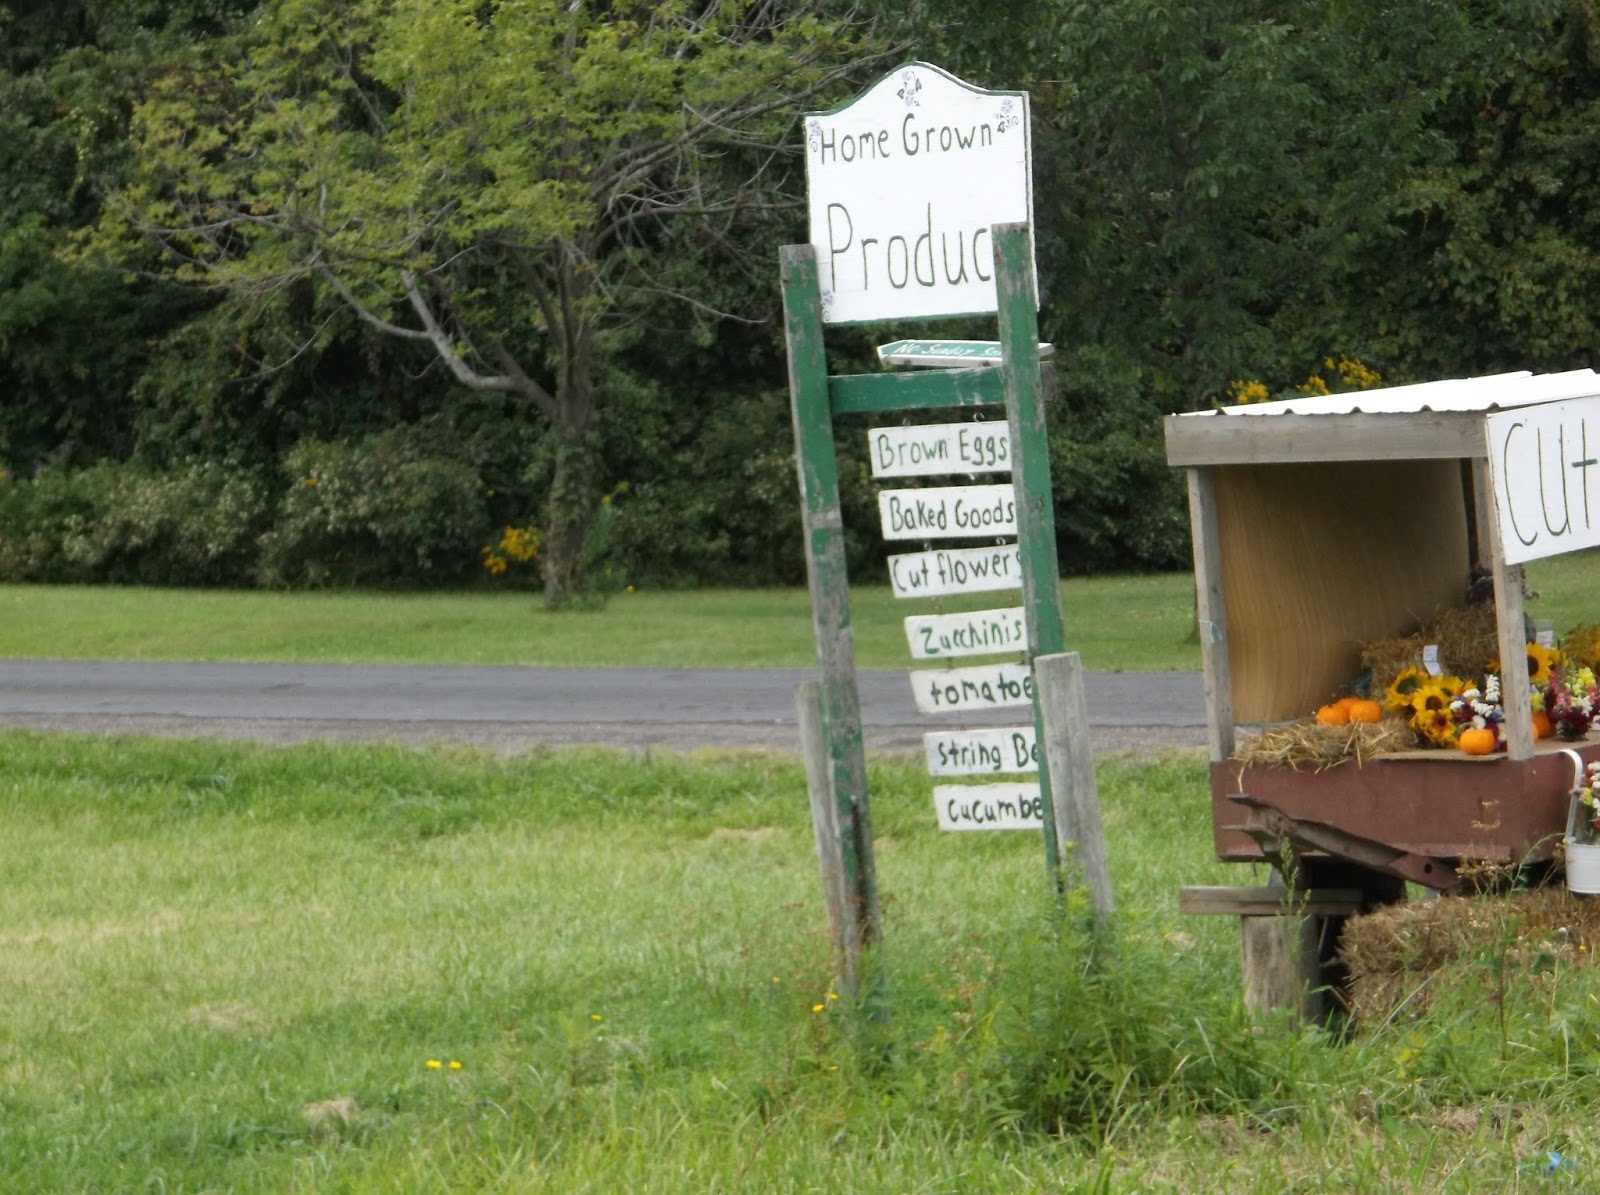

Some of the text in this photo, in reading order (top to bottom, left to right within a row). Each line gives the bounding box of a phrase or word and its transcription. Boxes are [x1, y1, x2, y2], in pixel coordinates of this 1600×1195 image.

[821, 113, 992, 165] Home Grown
[877, 428, 1008, 470] Brown Eggs
[889, 495, 1015, 533] Baked Goods
[892, 558, 929, 592] Cut
[920, 614, 1022, 655] Zucchinis
